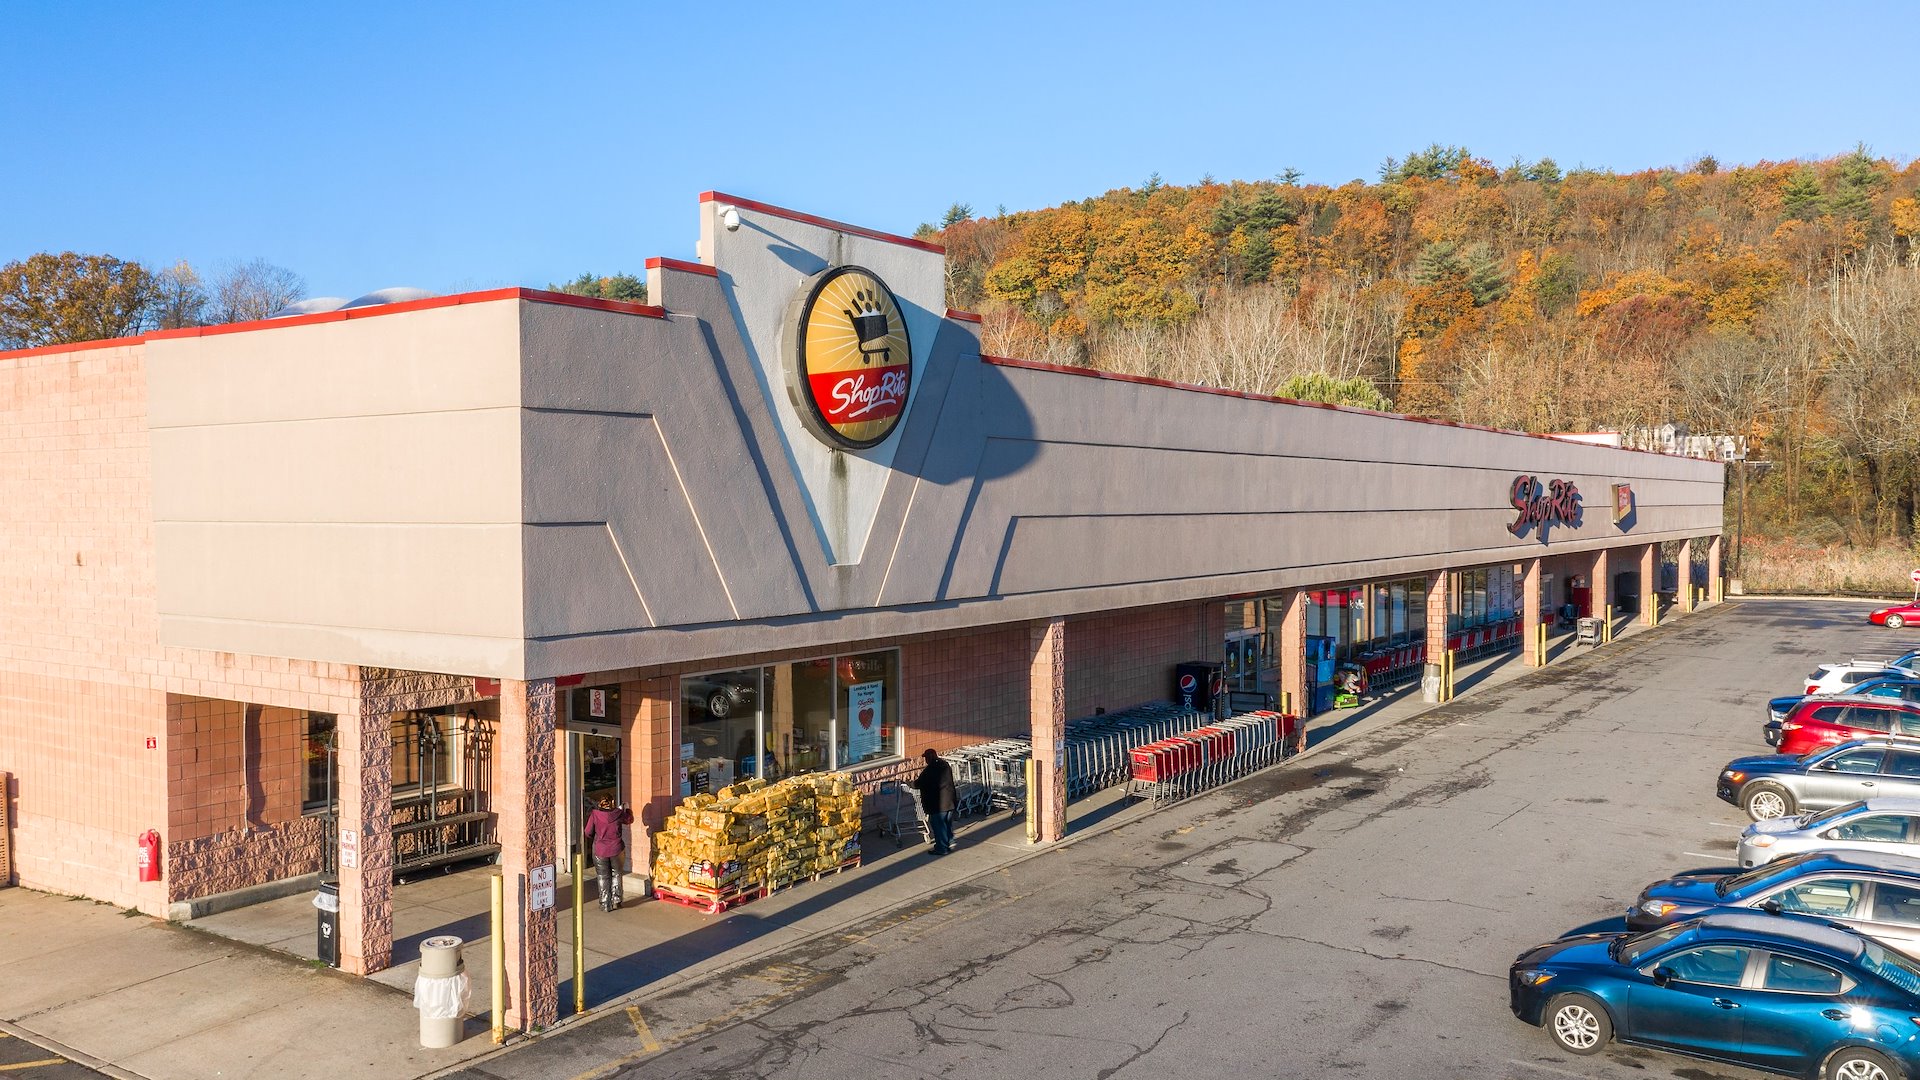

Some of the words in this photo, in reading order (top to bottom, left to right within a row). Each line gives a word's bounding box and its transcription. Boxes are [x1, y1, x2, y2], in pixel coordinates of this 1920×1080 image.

[829, 371, 906, 417] ShopRite
[1507, 475, 1579, 540] ShopRite
[537, 871, 547, 881] NO
[532, 880, 553, 891] PARKING
[537, 890, 548, 898] FIRE
[536, 897, 548, 906] LANE
